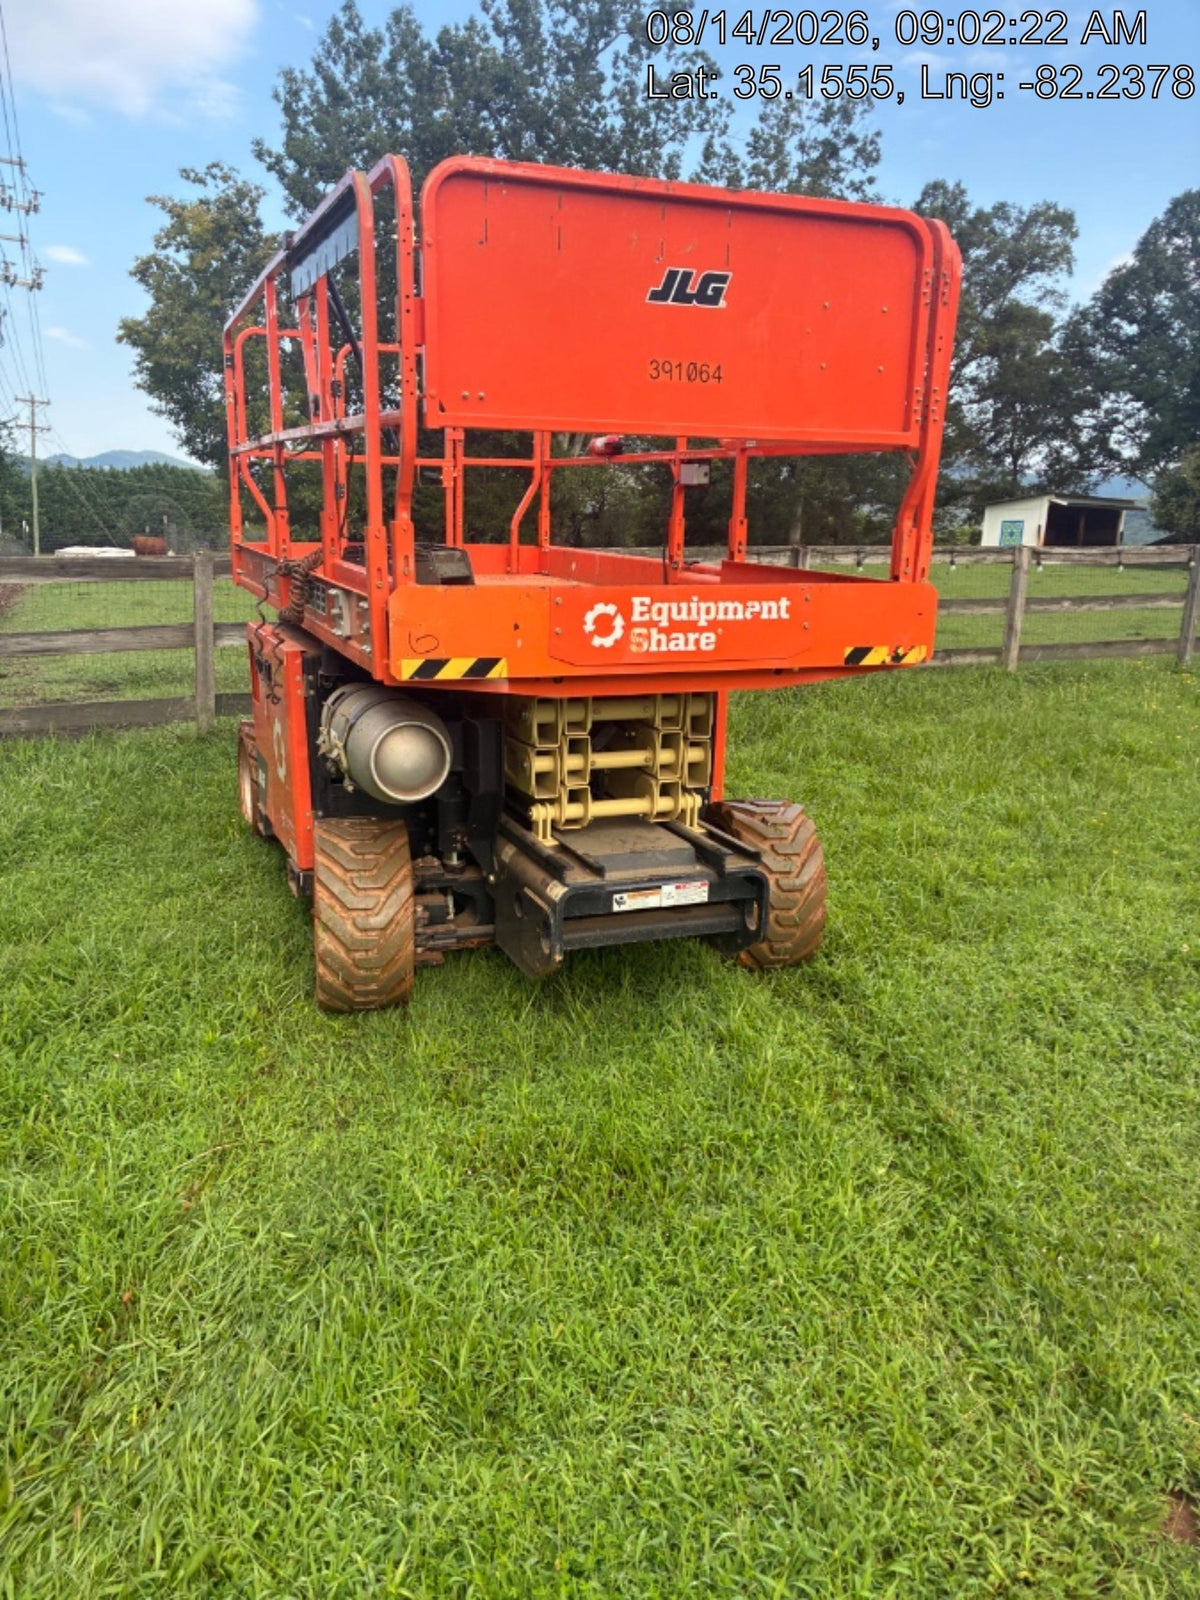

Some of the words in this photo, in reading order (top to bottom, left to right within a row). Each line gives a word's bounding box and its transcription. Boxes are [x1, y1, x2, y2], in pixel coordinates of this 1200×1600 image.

[646, 267, 733, 308] JLG
[649, 359, 723, 384] 391064
[630, 627, 717, 653] Share
